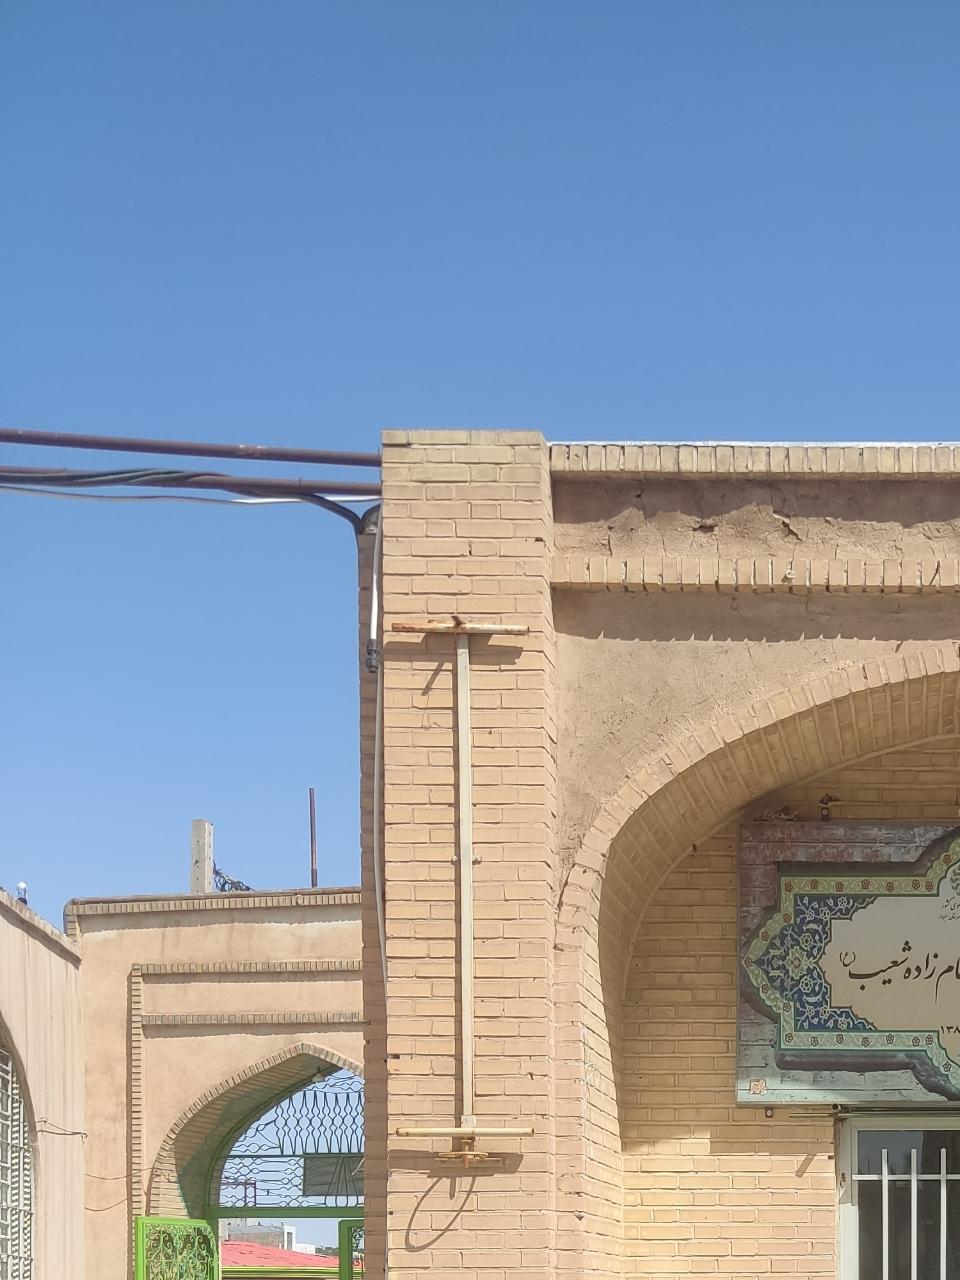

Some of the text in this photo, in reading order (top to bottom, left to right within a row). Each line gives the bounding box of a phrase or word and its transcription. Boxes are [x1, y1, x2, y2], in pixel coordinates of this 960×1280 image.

[839, 951, 856, 968] (ع)
[848, 940, 912, 991] شعیب
[903, 952, 939, 980] زاده
